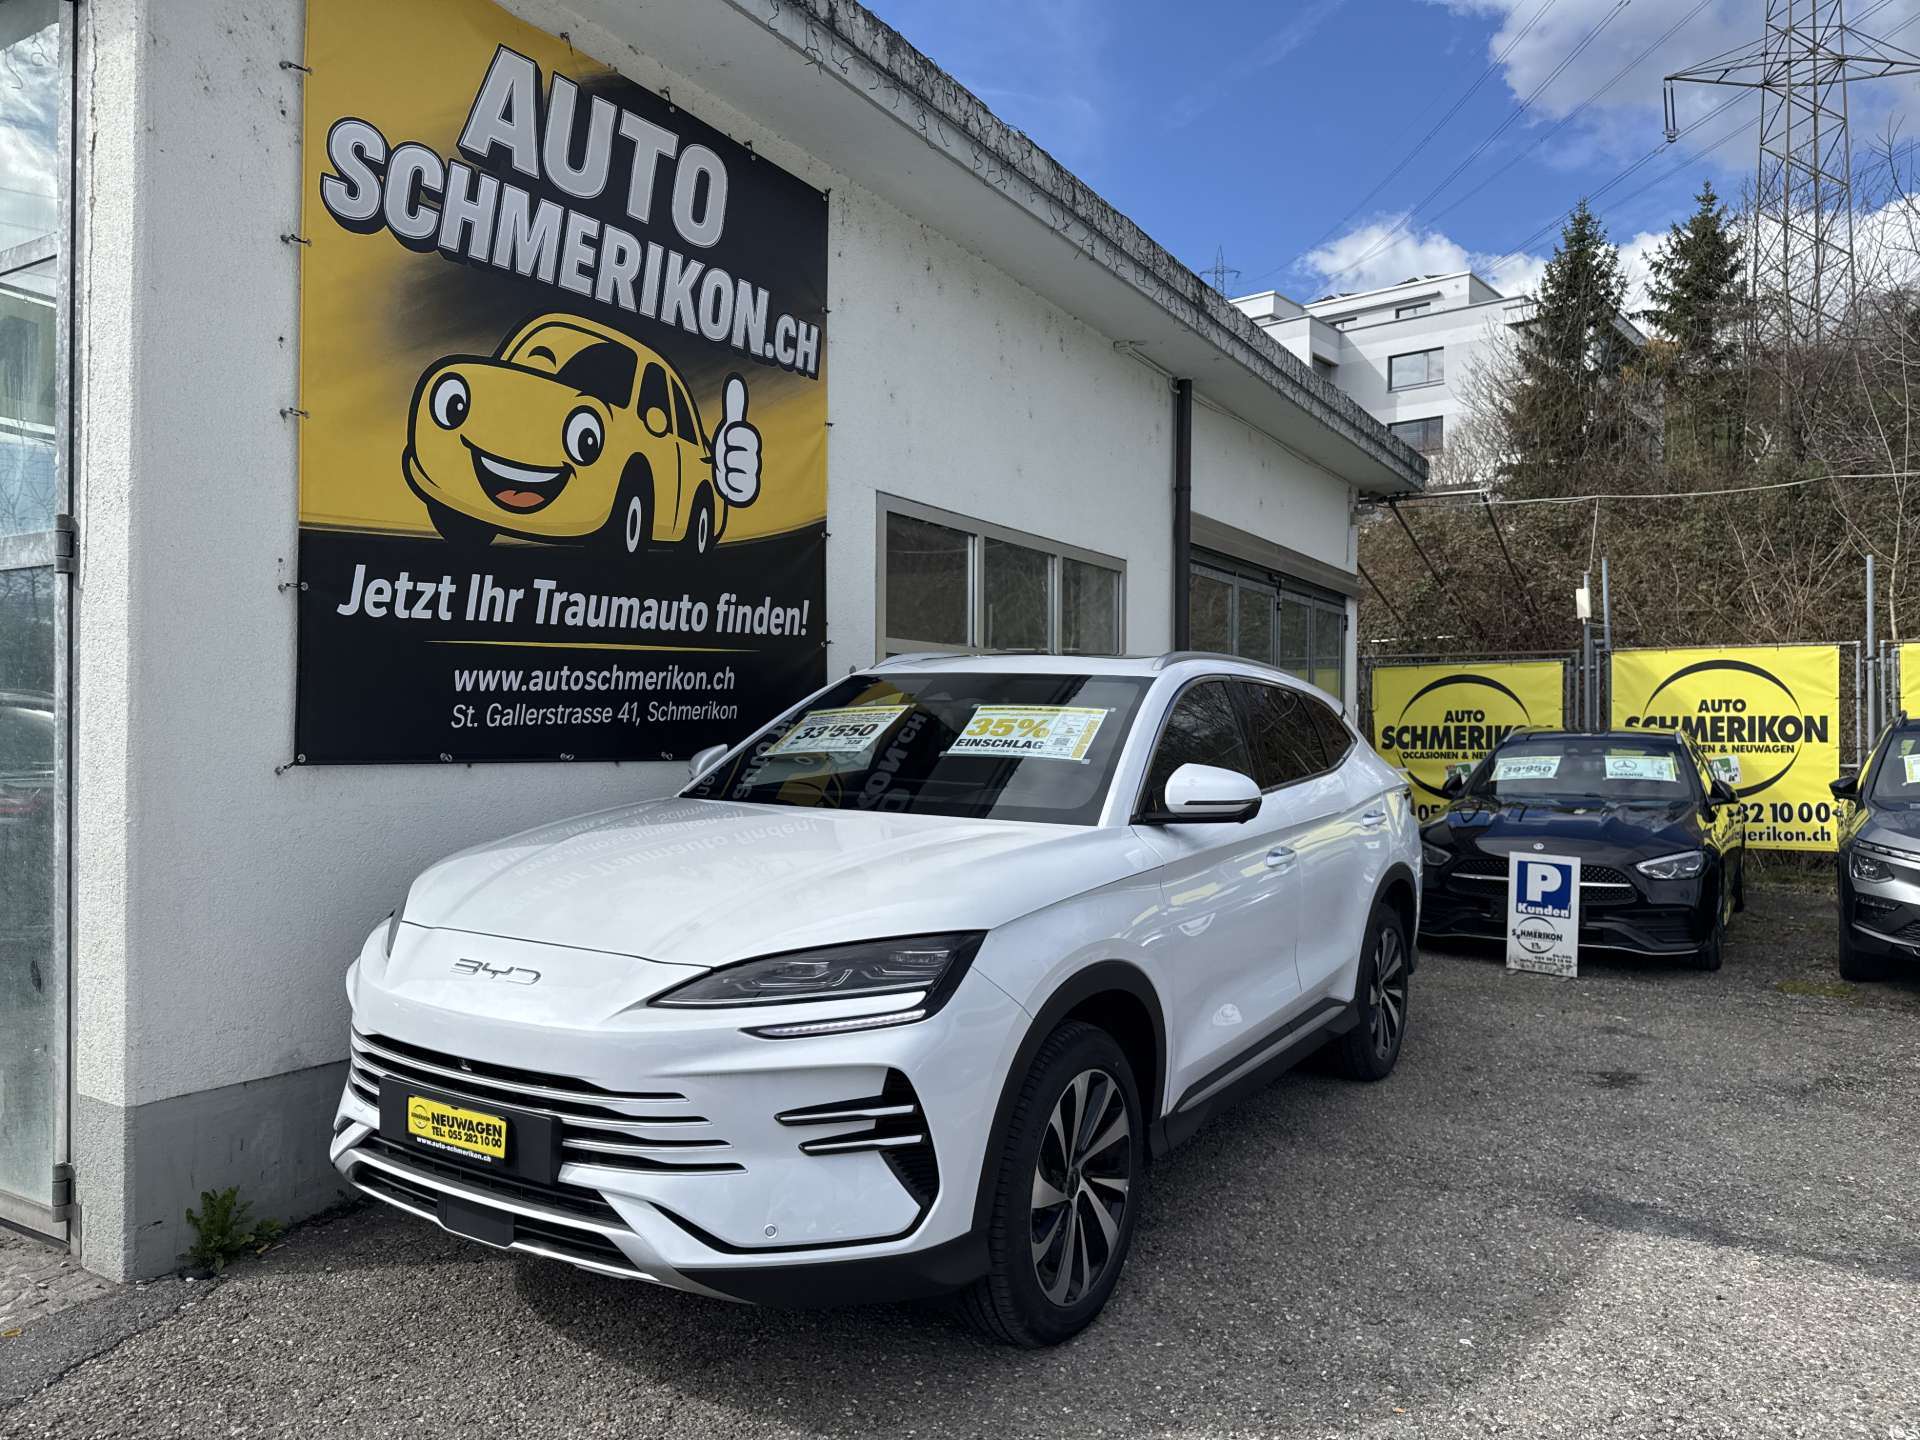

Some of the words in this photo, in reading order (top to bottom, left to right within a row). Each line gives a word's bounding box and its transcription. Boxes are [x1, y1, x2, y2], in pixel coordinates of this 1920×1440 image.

[459, 44, 729, 249] AUTO
[322, 119, 821, 381] SCHMERIKON.CH
[336, 563, 457, 622] Jetzt
[465, 573, 525, 623] Ihr
[533, 578, 709, 633] Traumauto
[715, 592, 810, 636] finden!
[453, 664, 736, 692] www.autoschmerikon.ch
[450, 703, 478, 729] St.
[486, 702, 613, 728] Gallerstrasse
[617, 701, 641, 727] 41,
[647, 700, 738, 722] Schmerikon
[1698, 698, 1747, 714] AUTO
[1443, 710, 1485, 724] AUTO
[795, 723, 879, 740] 33'550
[966, 717, 1050, 739] 35%
[955, 738, 1045, 750] EINSCHLAG
[1719, 744, 1728, 753] &
[1732, 744, 1795, 753] NEUWAGEN
[1402, 751, 1458, 760] OCCASIONEN
[1461, 751, 1469, 760] &
[1770, 802, 1794, 823] 10
[1798, 802, 1831, 823] 00
[1746, 826, 1831, 842] erikon.ch
[1526, 862, 1562, 903] P
[1517, 902, 1571, 918] Kunden
[1511, 928, 1563, 942] SHMERIKON
[449, 957, 542, 986] BYD
[431, 1111, 503, 1138] NEUWAGEN
[432, 1125, 446, 1138] TEL:
[448, 1129, 463, 1141] 055
[464, 1131, 479, 1145] 282
[480, 1135, 490, 1147] 10
[491, 1137, 502, 1149] 00
